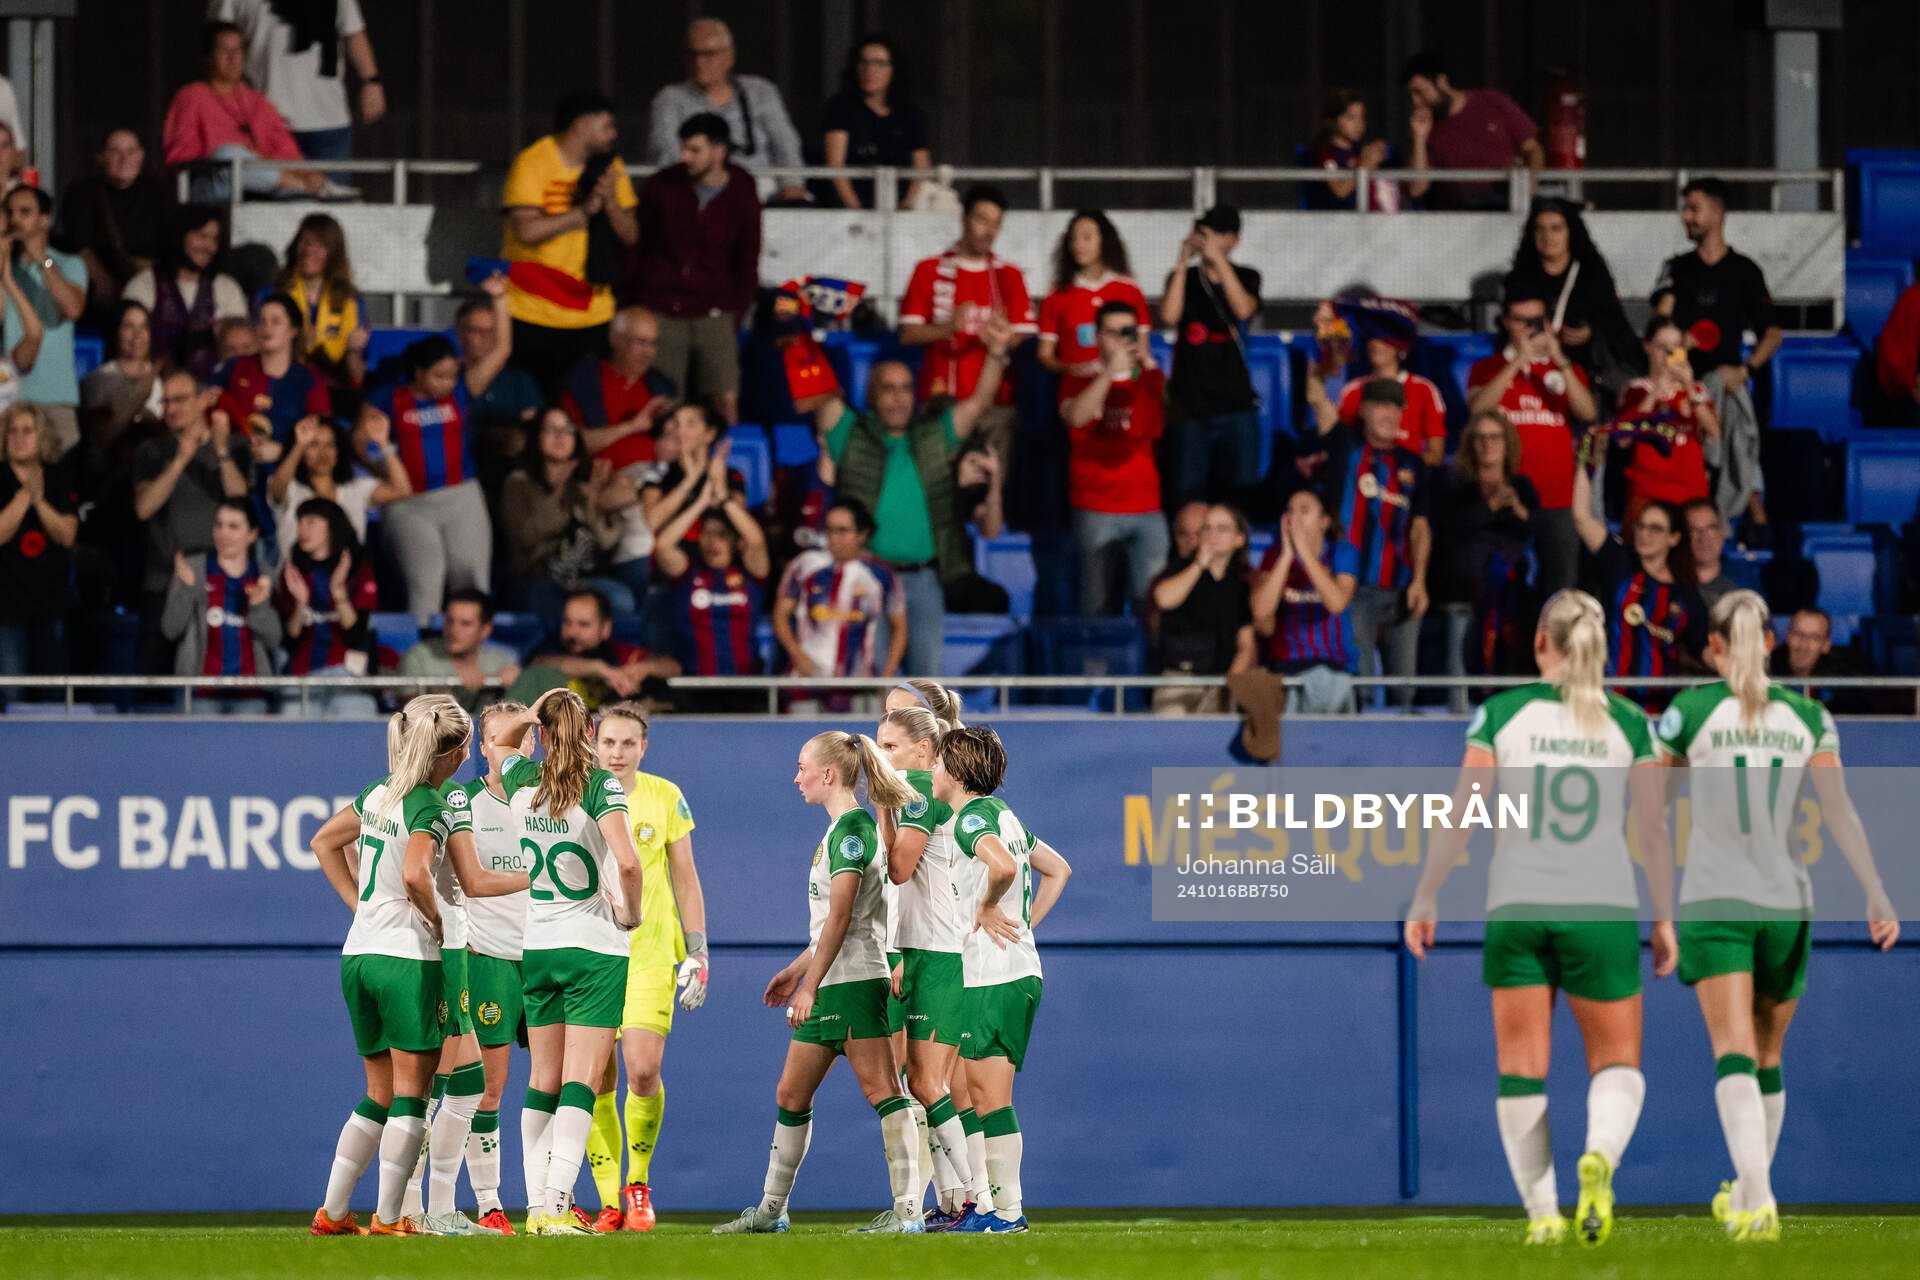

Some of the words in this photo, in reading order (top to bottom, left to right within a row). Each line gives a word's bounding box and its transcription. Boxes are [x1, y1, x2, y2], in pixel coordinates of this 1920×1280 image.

[8, 795, 101, 870] FC
[118, 795, 356, 870] BARC
[525, 815, 569, 834] HASUND
[1530, 763, 1599, 844] 19
[1734, 755, 1784, 834] 11
[520, 837, 599, 901] 20
[1312, 794, 1470, 883] QU
